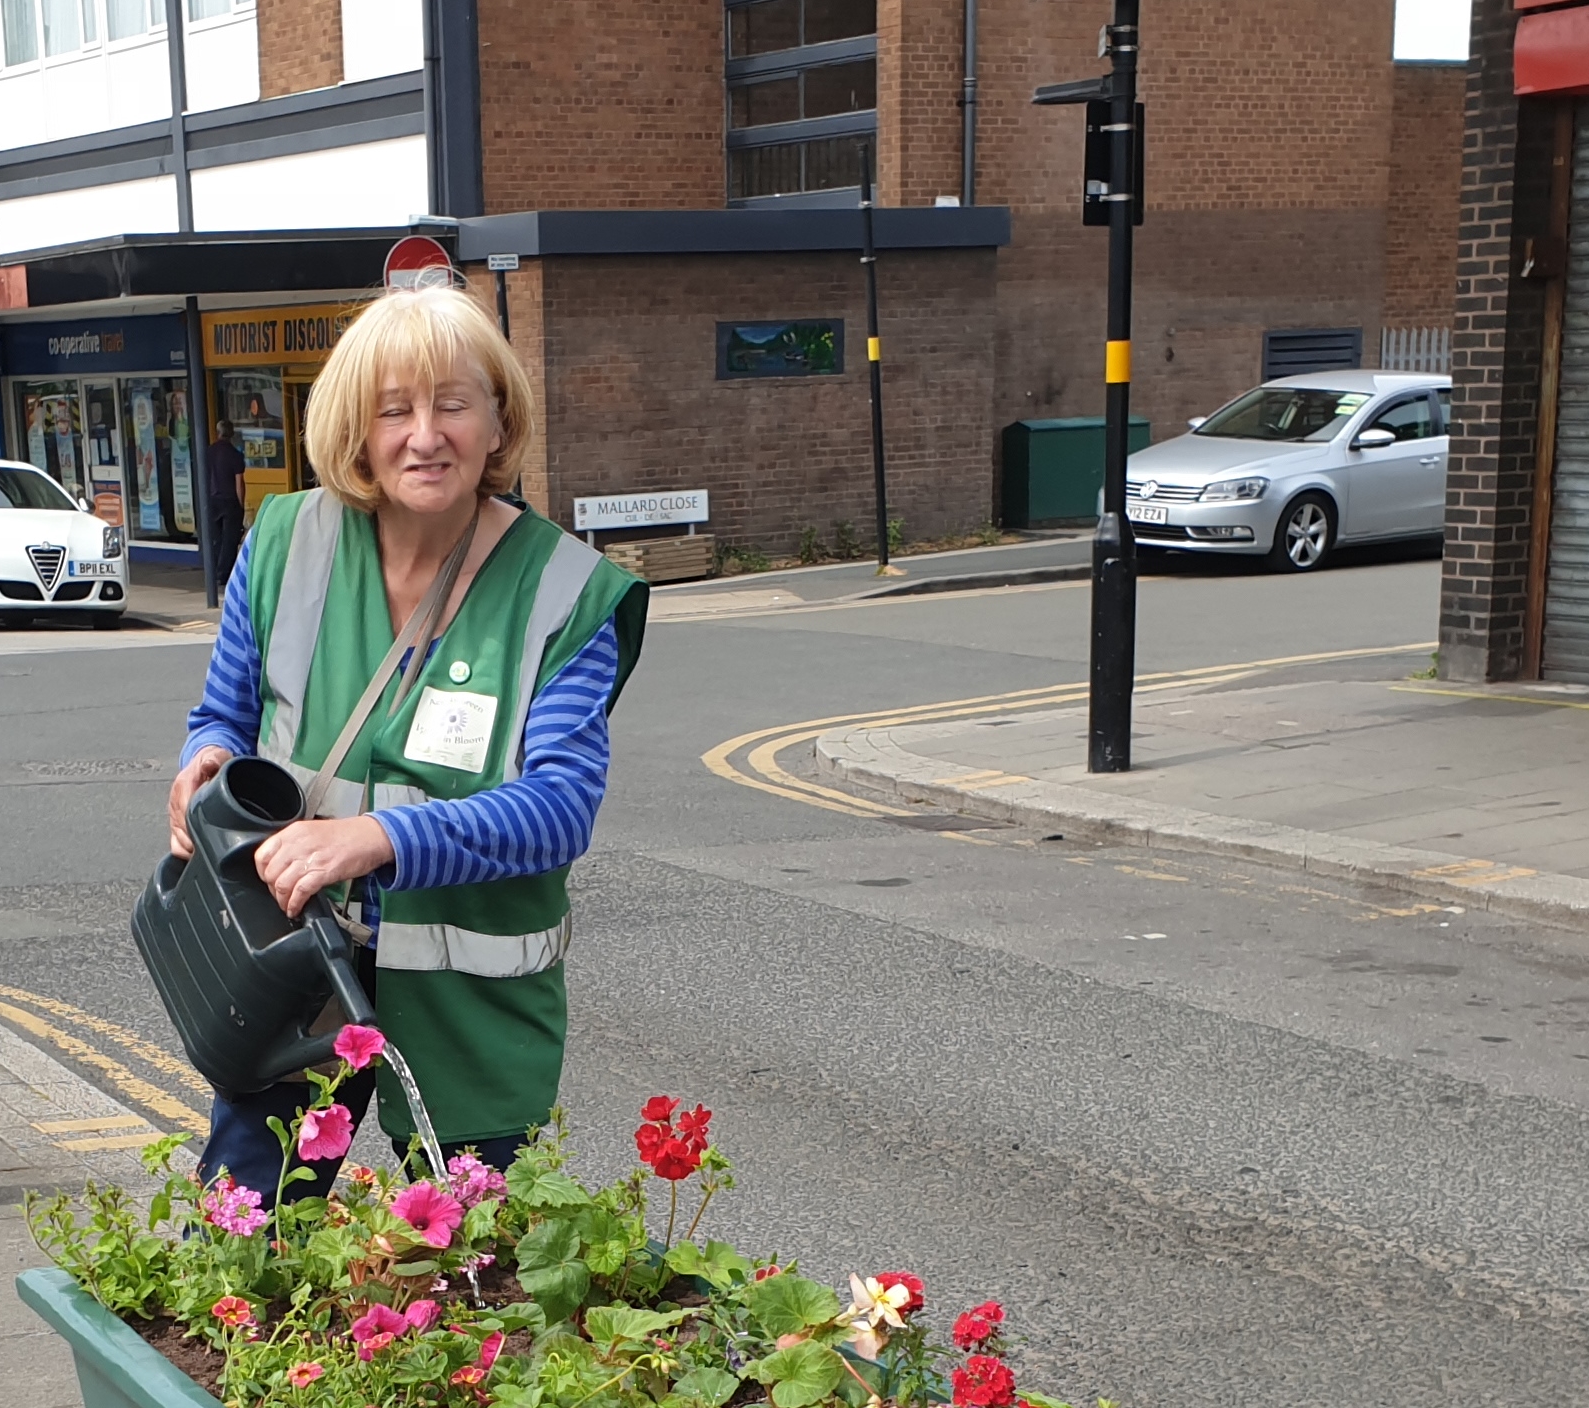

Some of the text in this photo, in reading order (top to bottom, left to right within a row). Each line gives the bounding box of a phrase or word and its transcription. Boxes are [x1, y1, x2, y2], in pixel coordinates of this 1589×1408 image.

[213, 320, 278, 355] MOTORIST
[48, 330, 100, 360] co-operative
[597, 495, 699, 516] MALLARD CLOSE
[1144, 508, 1162, 520] EZA
[99, 562, 117, 574] EXL
[465, 699, 484, 713] reen
[454, 735, 485, 745] Bloom
